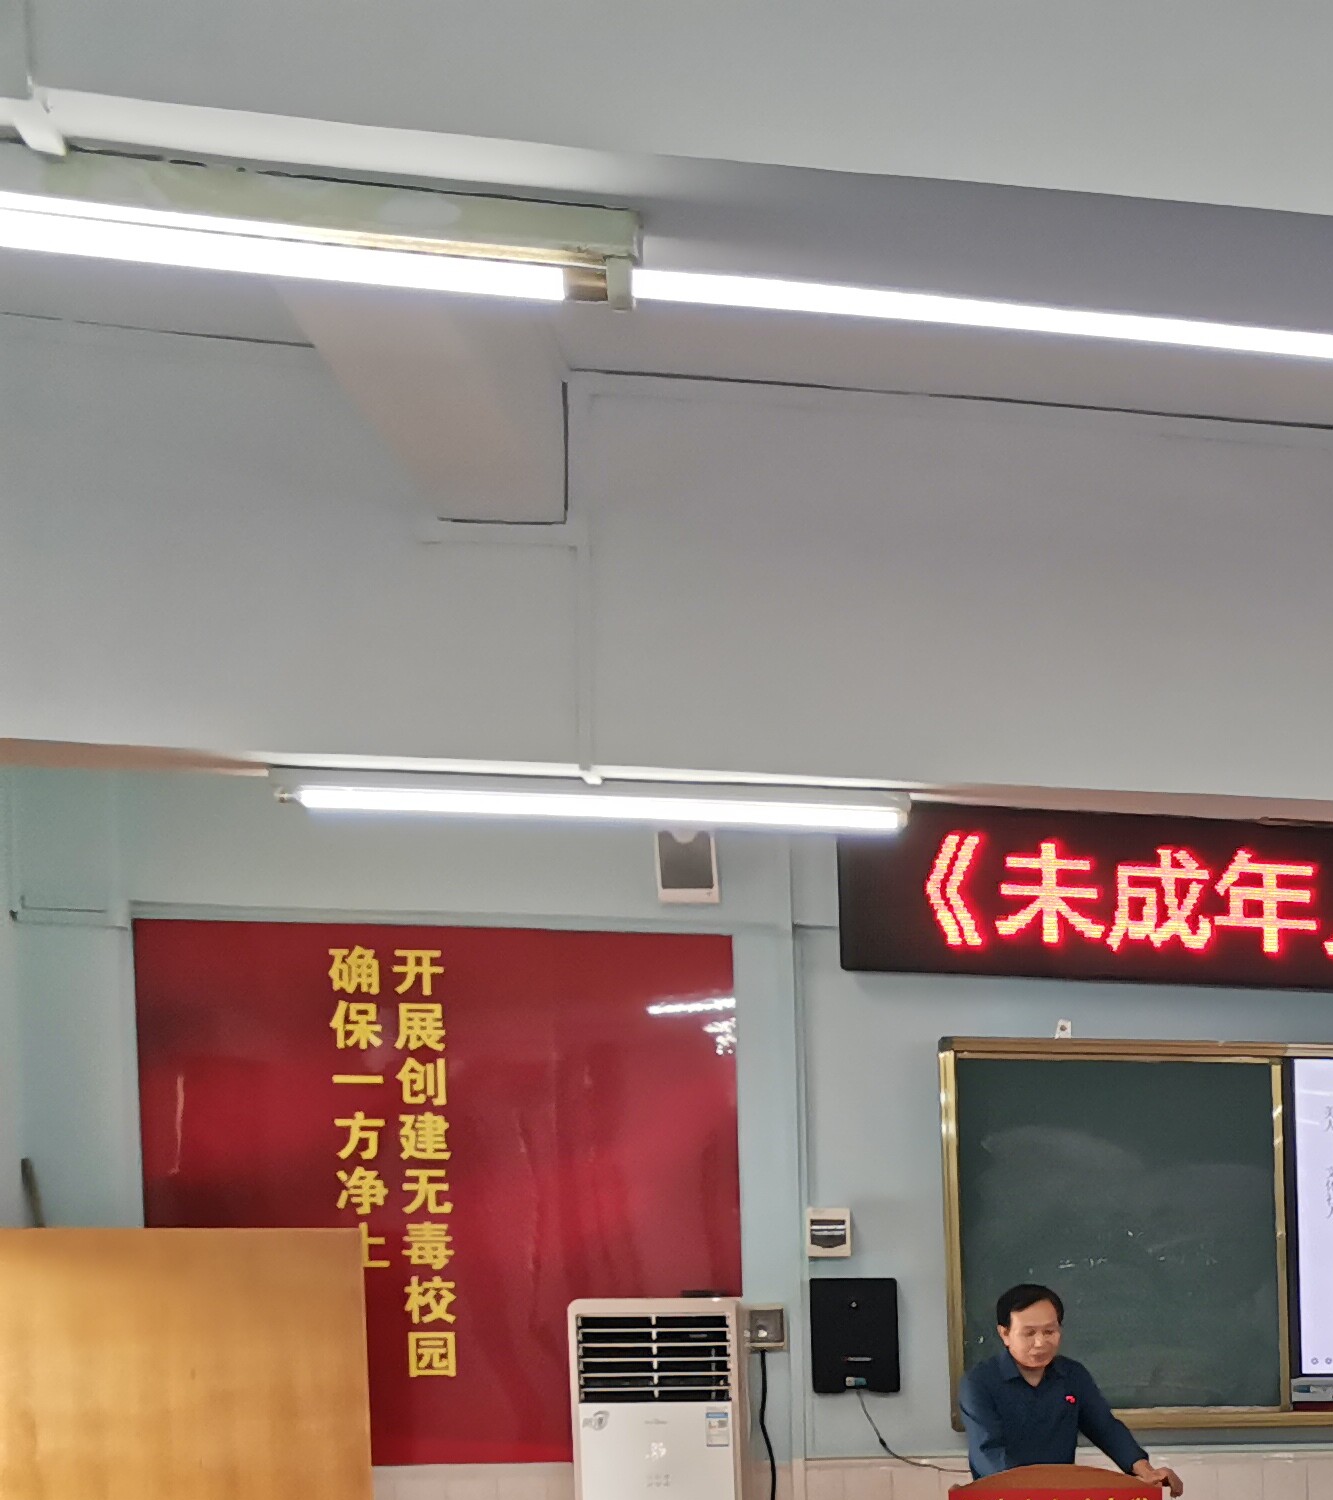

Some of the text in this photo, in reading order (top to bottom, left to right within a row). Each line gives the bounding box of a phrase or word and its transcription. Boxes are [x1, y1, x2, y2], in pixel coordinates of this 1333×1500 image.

[392, 947, 457, 1379] 开展创建无毒校园
